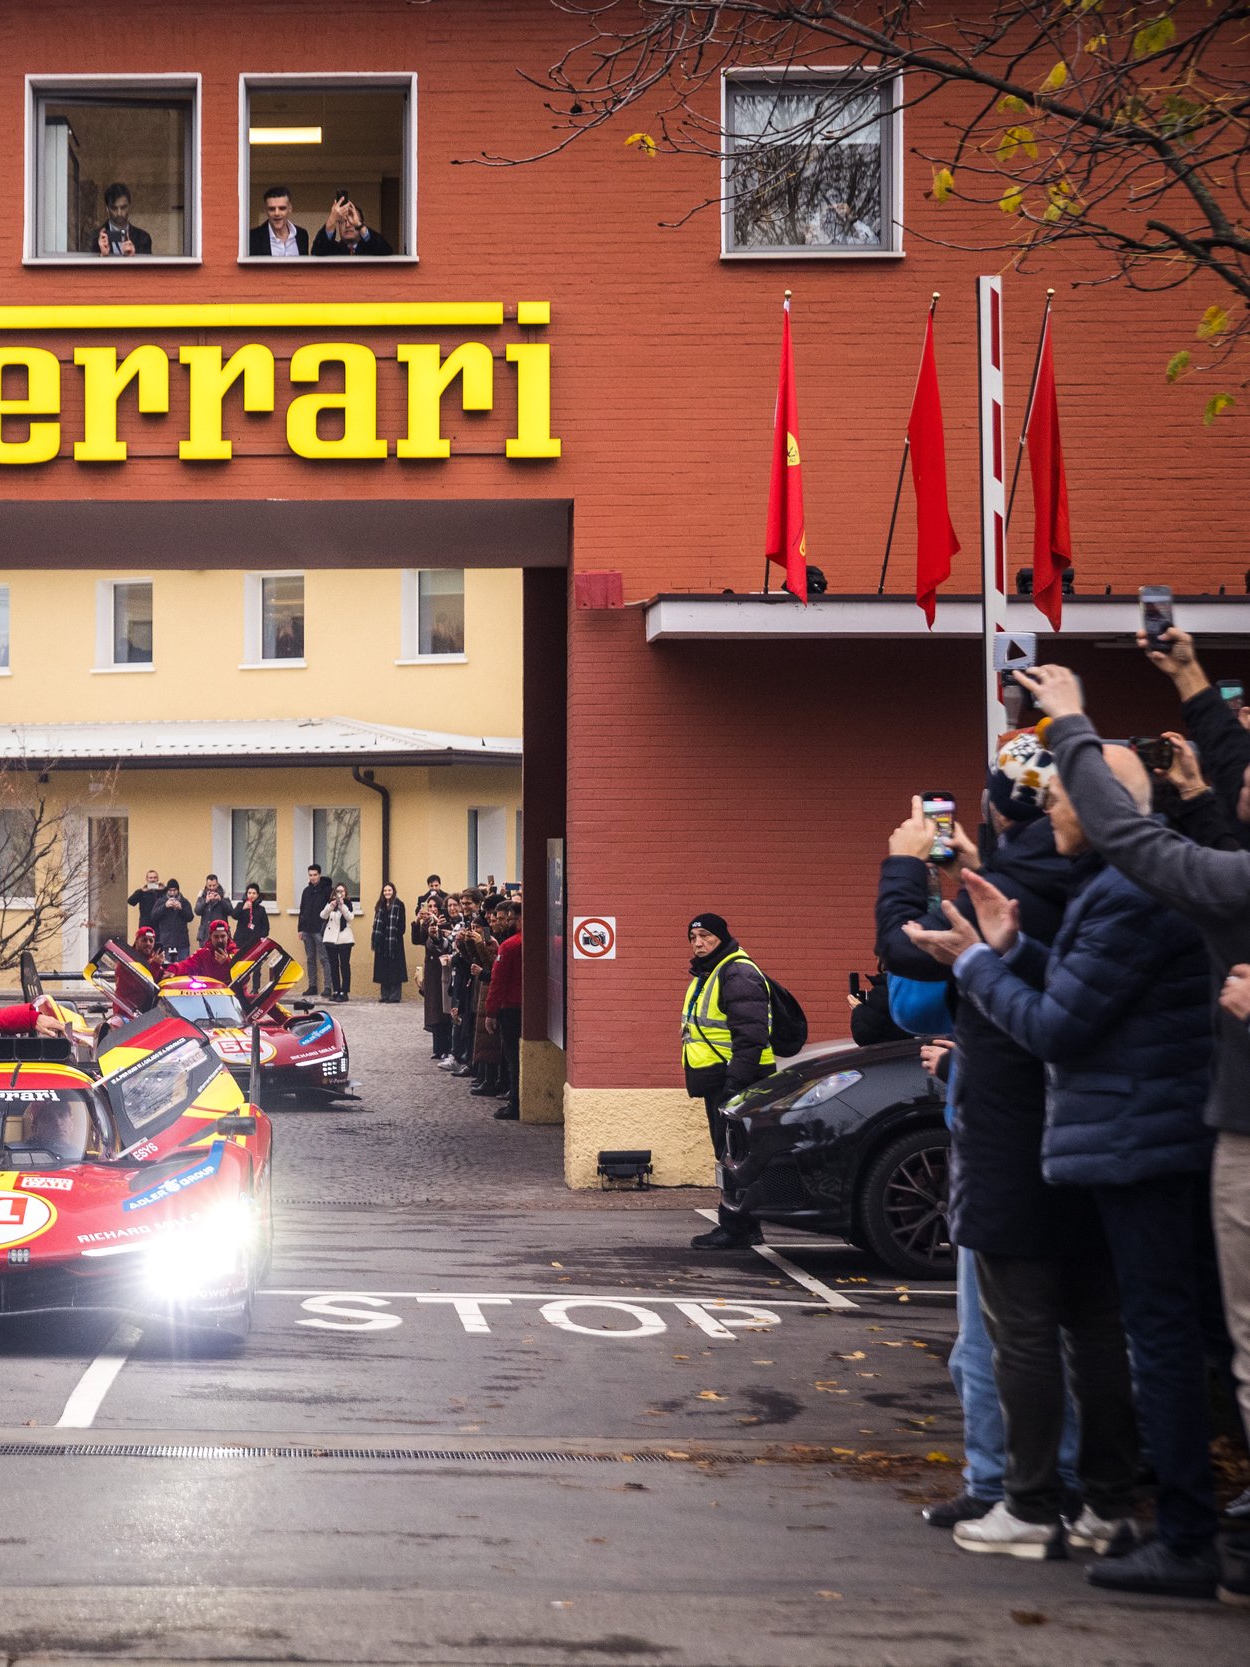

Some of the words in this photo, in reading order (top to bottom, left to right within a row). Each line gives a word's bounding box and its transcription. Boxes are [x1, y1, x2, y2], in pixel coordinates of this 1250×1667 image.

[132, 1142, 159, 1161] ESYS
[129, 1189, 168, 1209] ADLER
[181, 1166, 215, 1186] GROUP
[77, 1226, 151, 1244] RICHARD
[295, 1294, 782, 1340] STOP
